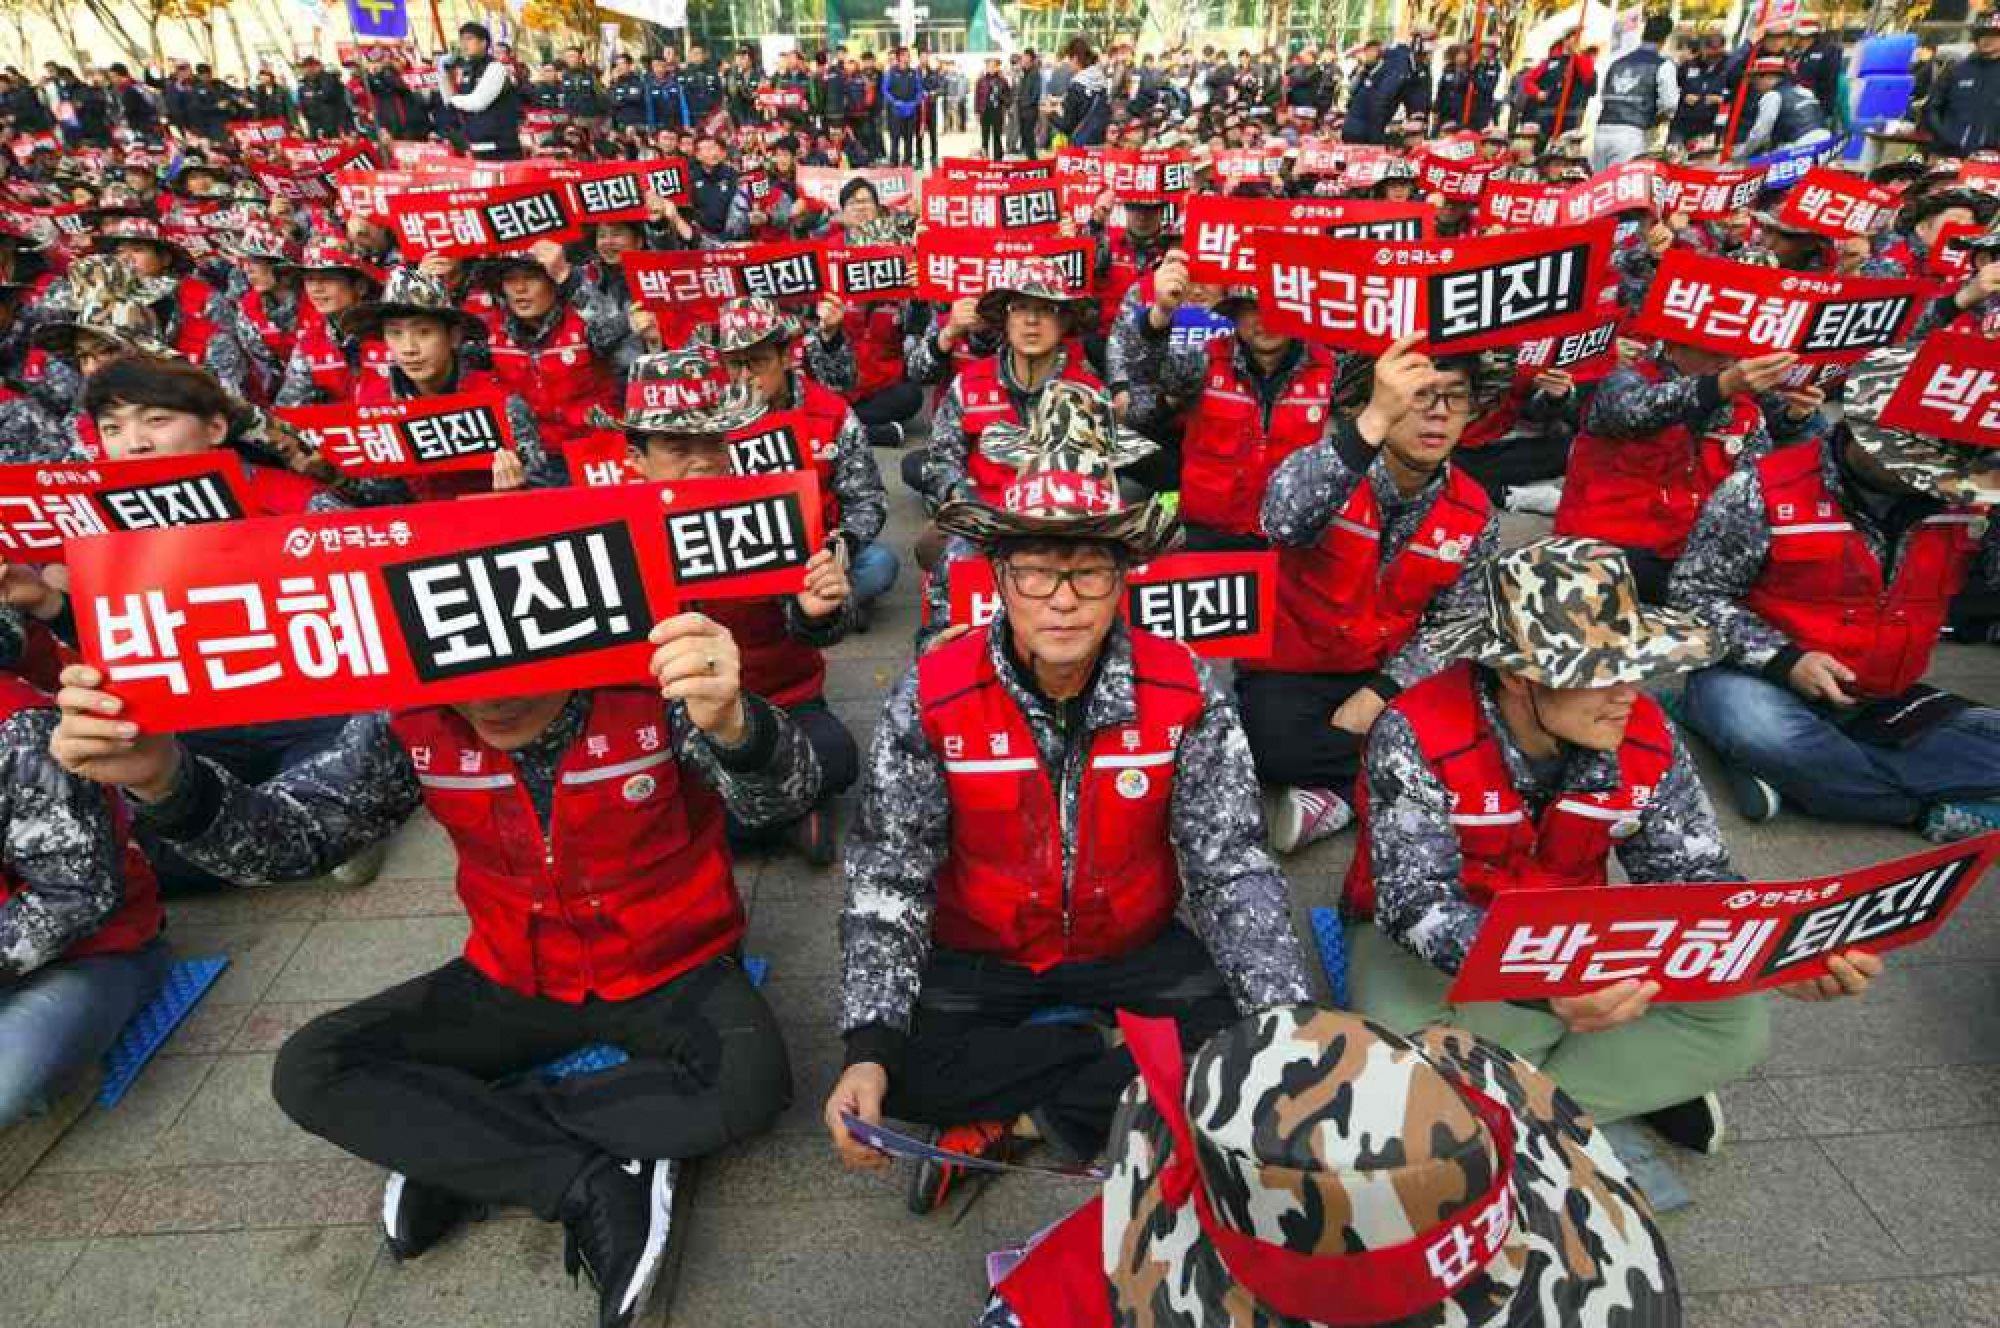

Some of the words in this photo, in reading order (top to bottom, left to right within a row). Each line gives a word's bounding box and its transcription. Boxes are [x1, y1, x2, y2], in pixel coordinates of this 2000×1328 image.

[400, 210, 488, 249] 박근혜
[488, 193, 562, 241] 퇴진!
[579, 175, 641, 213] 퇴진!
[928, 195, 996, 226] 박근혜
[637, 268, 736, 302] 박근혜
[743, 255, 817, 298] 퇴진!
[1271, 262, 1418, 341] 박근혜
[1441, 251, 1573, 337] 퇴진!
[1663, 277, 1809, 349] 박근혜
[1806, 298, 1907, 349] 퇴진!
[407, 409, 500, 460] 퇴진!
[0, 493, 110, 548] 근혜
[669, 499, 799, 580] 퇴진!
[95, 570, 390, 696] 박근혜
[406, 532, 632, 668] 퇴진!
[1139, 575, 1248, 640] 퇴진!
[1499, 918, 1779, 984] 박근혜
[1775, 860, 1960, 967] 퇴진!
